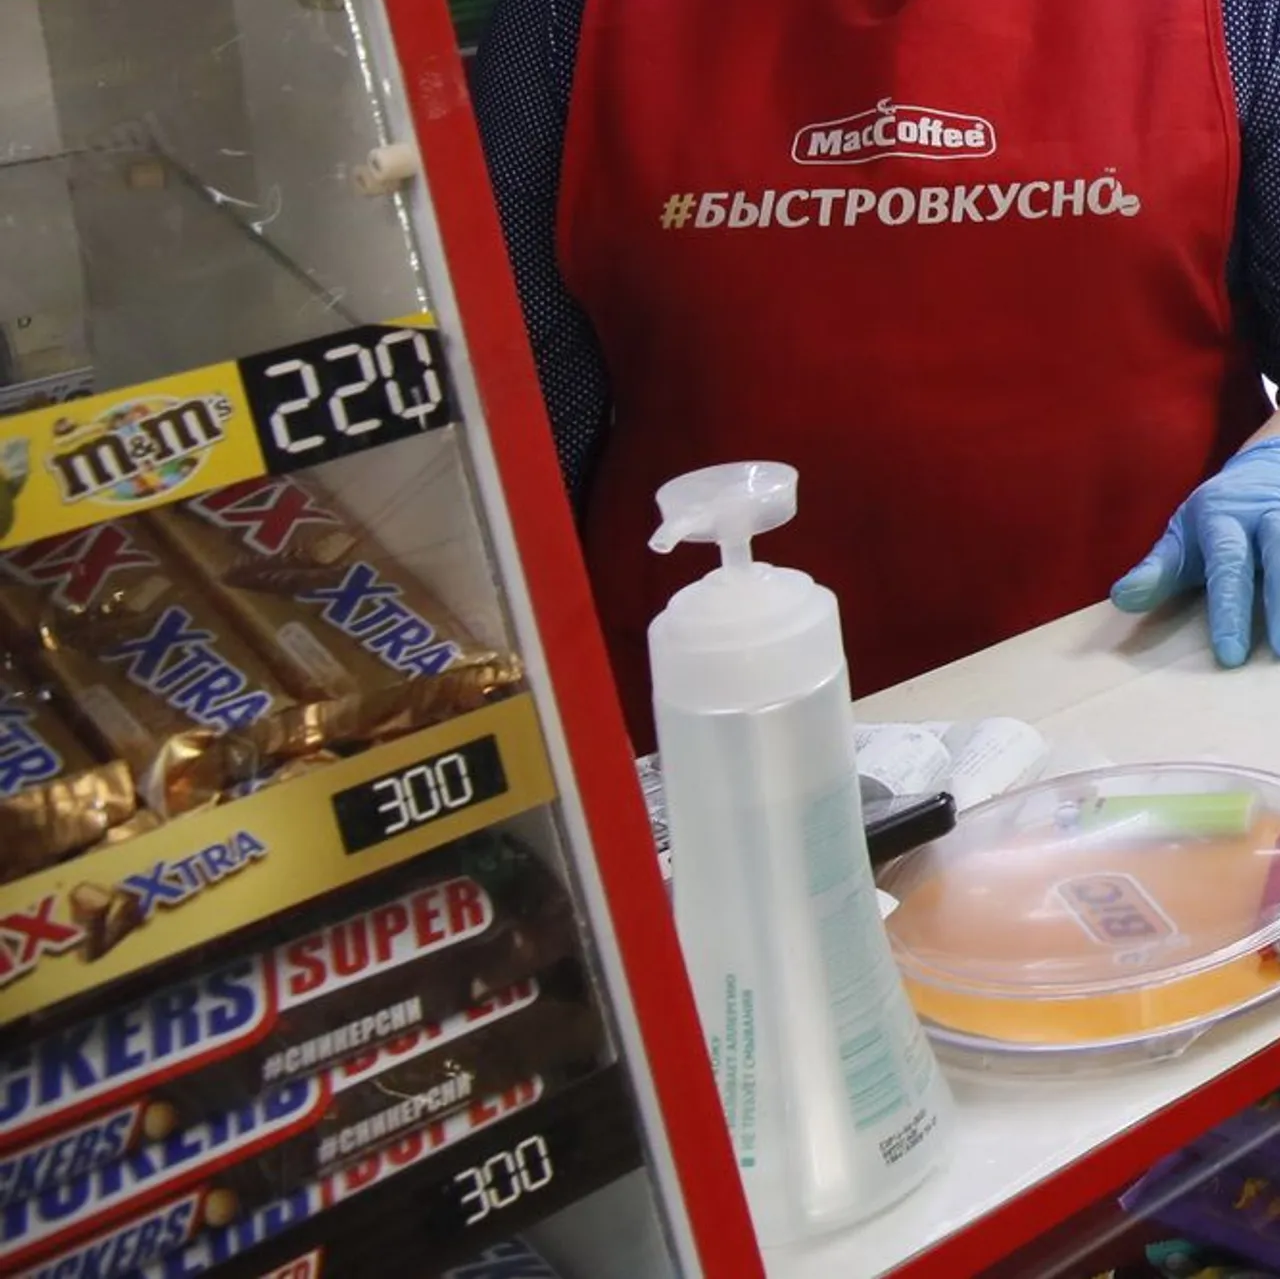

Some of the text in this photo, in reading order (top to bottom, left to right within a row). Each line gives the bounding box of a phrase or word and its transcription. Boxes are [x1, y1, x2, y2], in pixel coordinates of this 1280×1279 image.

[807, 115, 986, 157] MacCoffee
[660, 175, 1122, 230] #БЫСТРОВКУСНО
[264, 328, 443, 455] 220
[302, 561, 463, 680] XTRA
[103, 606, 273, 733] XTRA
[371, 753, 474, 835] 300
[122, 829, 268, 911] XTRA
[287, 877, 485, 997] SUPER
[453, 1135, 553, 1226] 300
